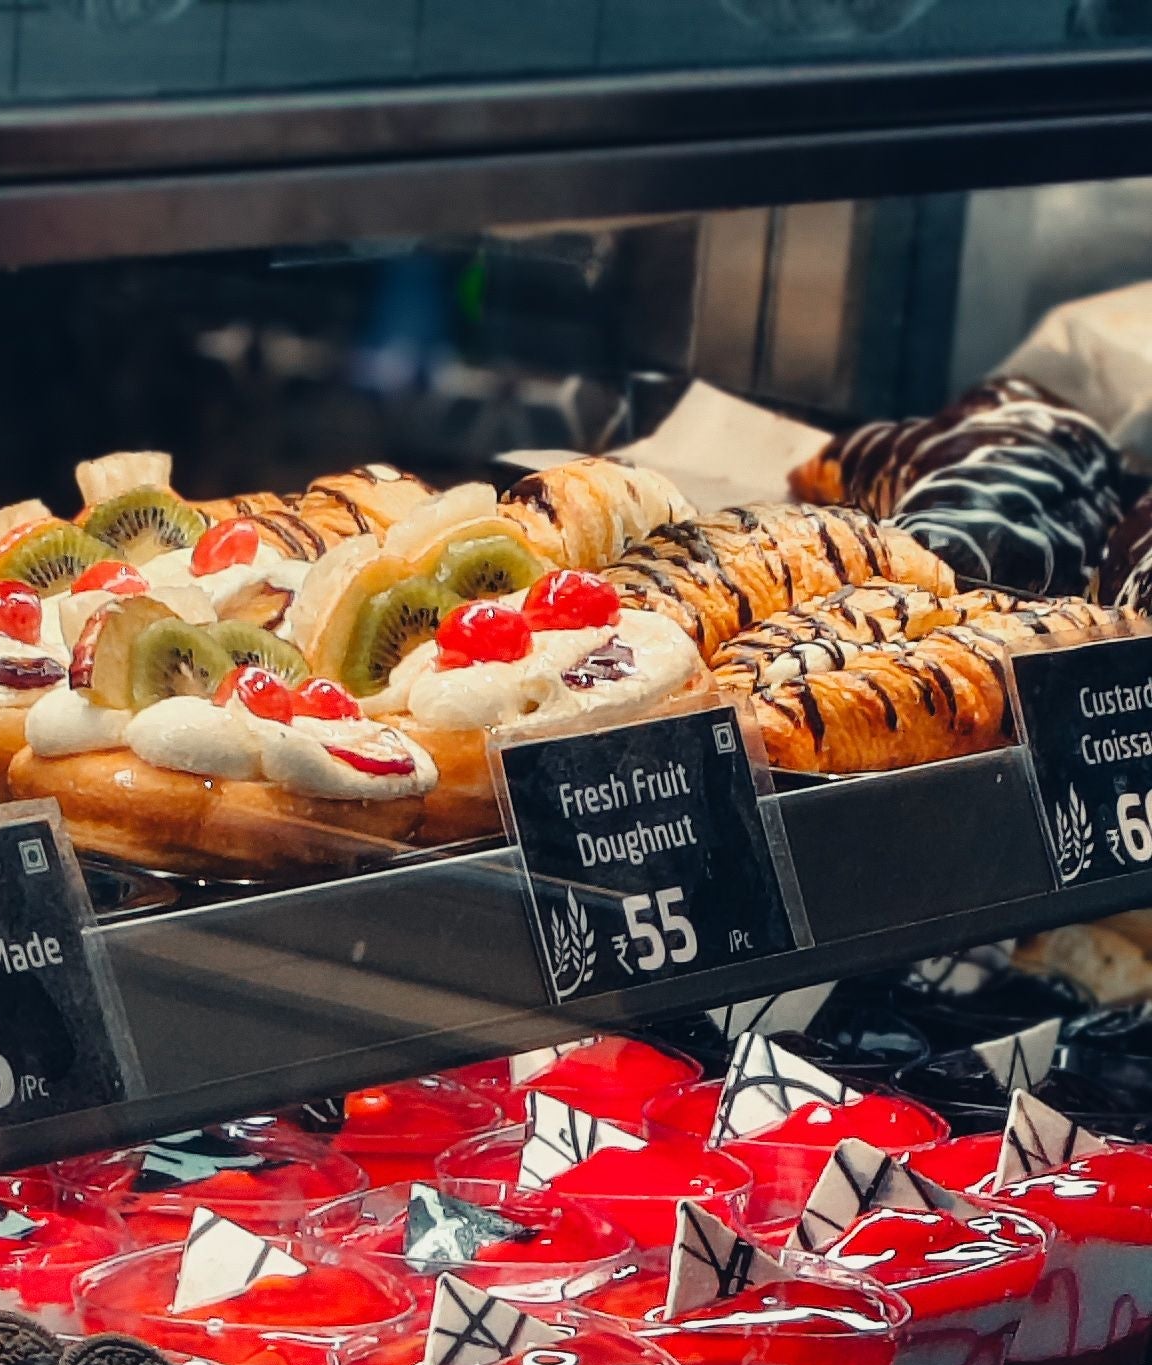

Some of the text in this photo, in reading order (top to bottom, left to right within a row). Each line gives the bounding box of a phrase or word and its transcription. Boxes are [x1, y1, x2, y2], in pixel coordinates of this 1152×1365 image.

[559, 761, 691, 819] Fresh Fruit
[577, 815, 697, 867] Doughnut
[1106, 789, 1152, 865] ₹6
